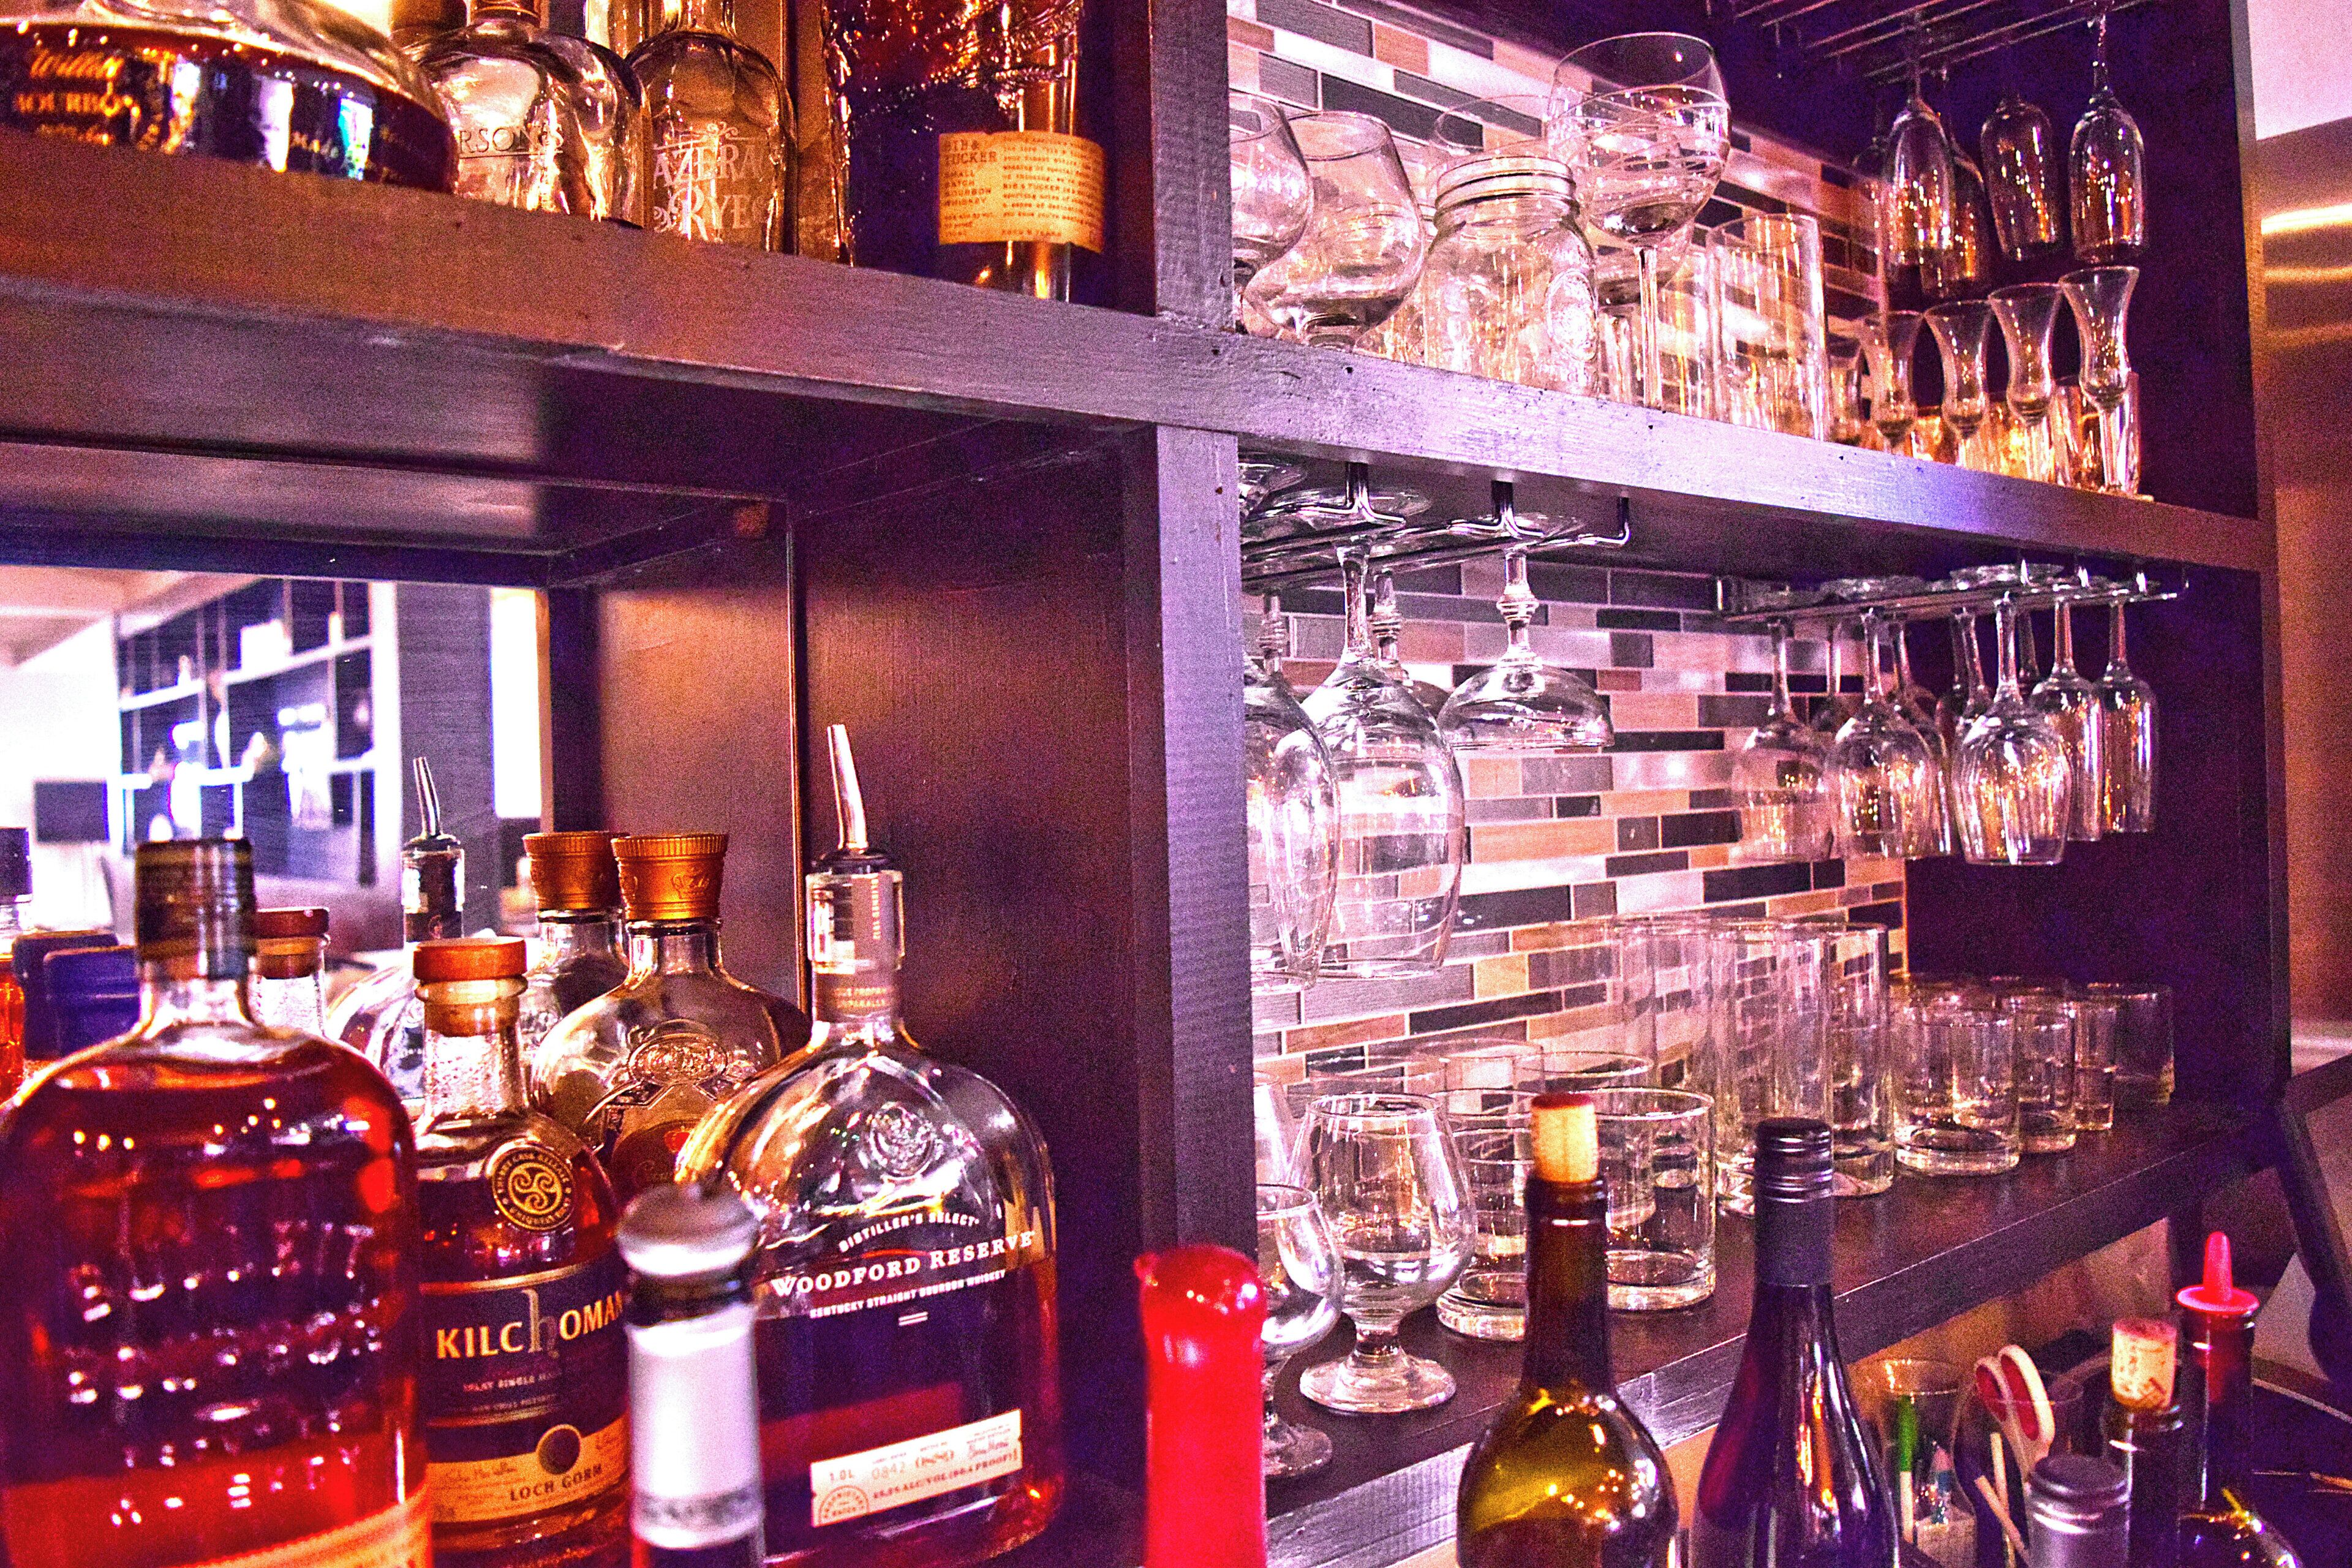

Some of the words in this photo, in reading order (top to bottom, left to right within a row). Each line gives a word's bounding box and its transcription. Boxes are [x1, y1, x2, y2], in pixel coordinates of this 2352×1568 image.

[654, 143, 764, 190] AZERA
[839, 1213, 923, 1253] DISTILLER'S
[929, 1212, 976, 1227] SELECT
[771, 1256, 921, 1298] WOODFORD
[929, 1231, 1031, 1270] RESERVE
[810, 1299, 865, 1319] KENTUCKY
[866, 1288, 917, 1309] STRAIGHT
[919, 1278, 965, 1298] BOURBON
[967, 1268, 1006, 1287] WHISKEY
[510, 1480, 554, 1502] LOCH
[562, 1463, 603, 1490] GORM
